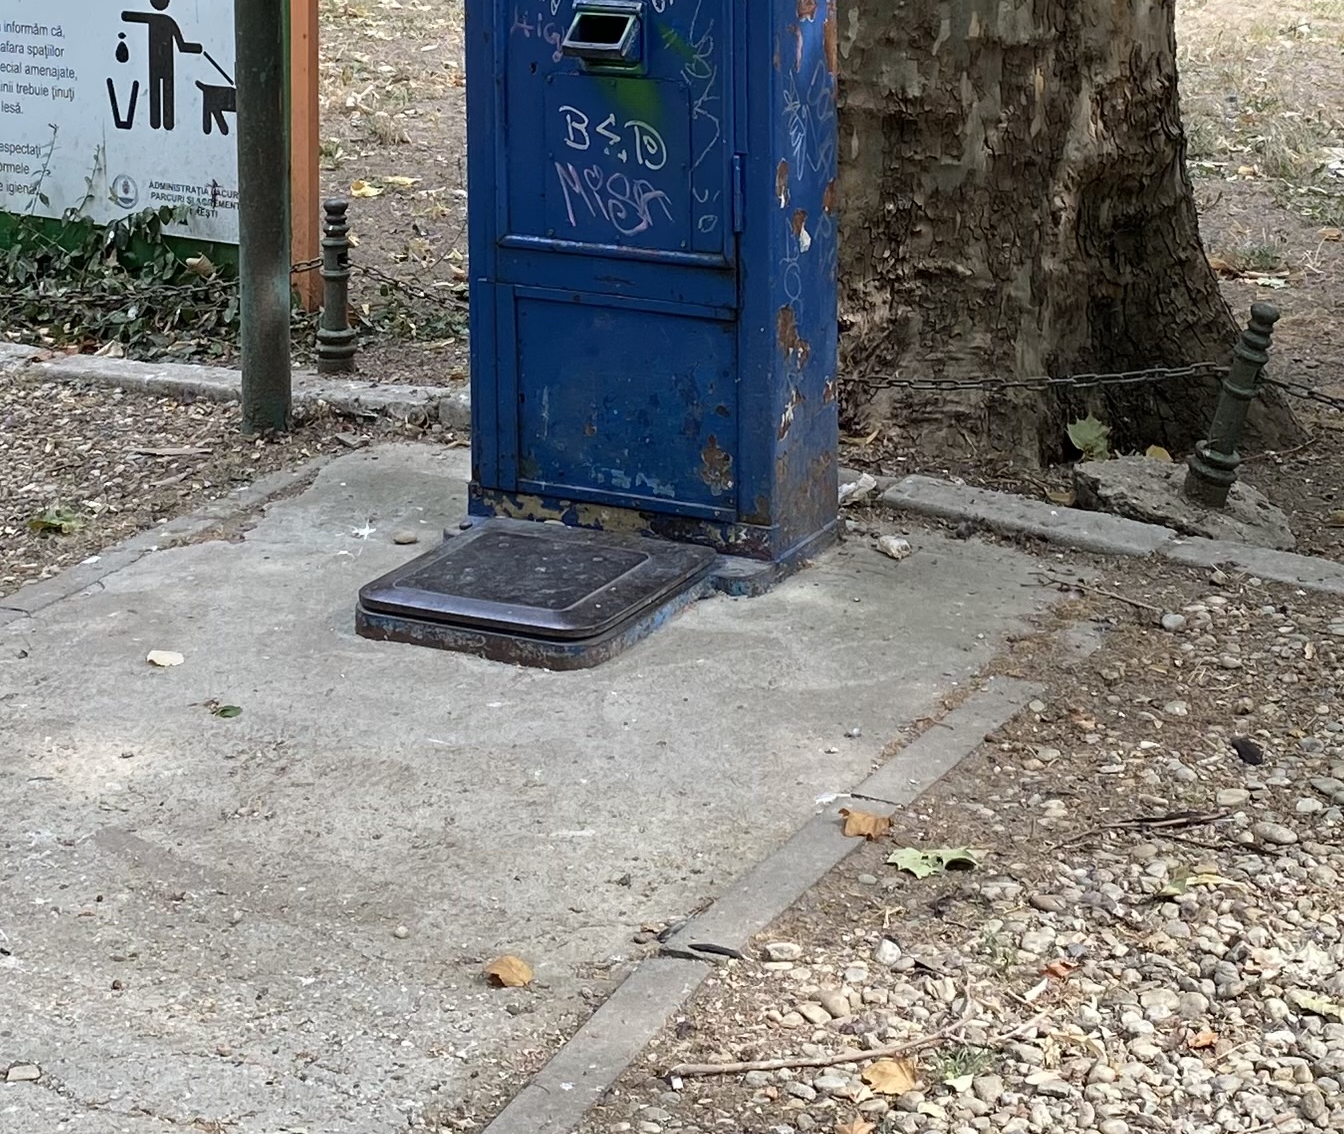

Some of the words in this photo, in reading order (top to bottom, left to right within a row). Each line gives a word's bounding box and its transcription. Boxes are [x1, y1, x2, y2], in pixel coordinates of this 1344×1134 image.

[4, 20, 48, 36] informăm
[0, 40, 24, 54] afara
[25, 65, 77, 81] amenajate,
[16, 83, 49, 96] trebuie
[151, 192, 184, 203] PARCURI
[210, 188, 240, 199] LACUR
